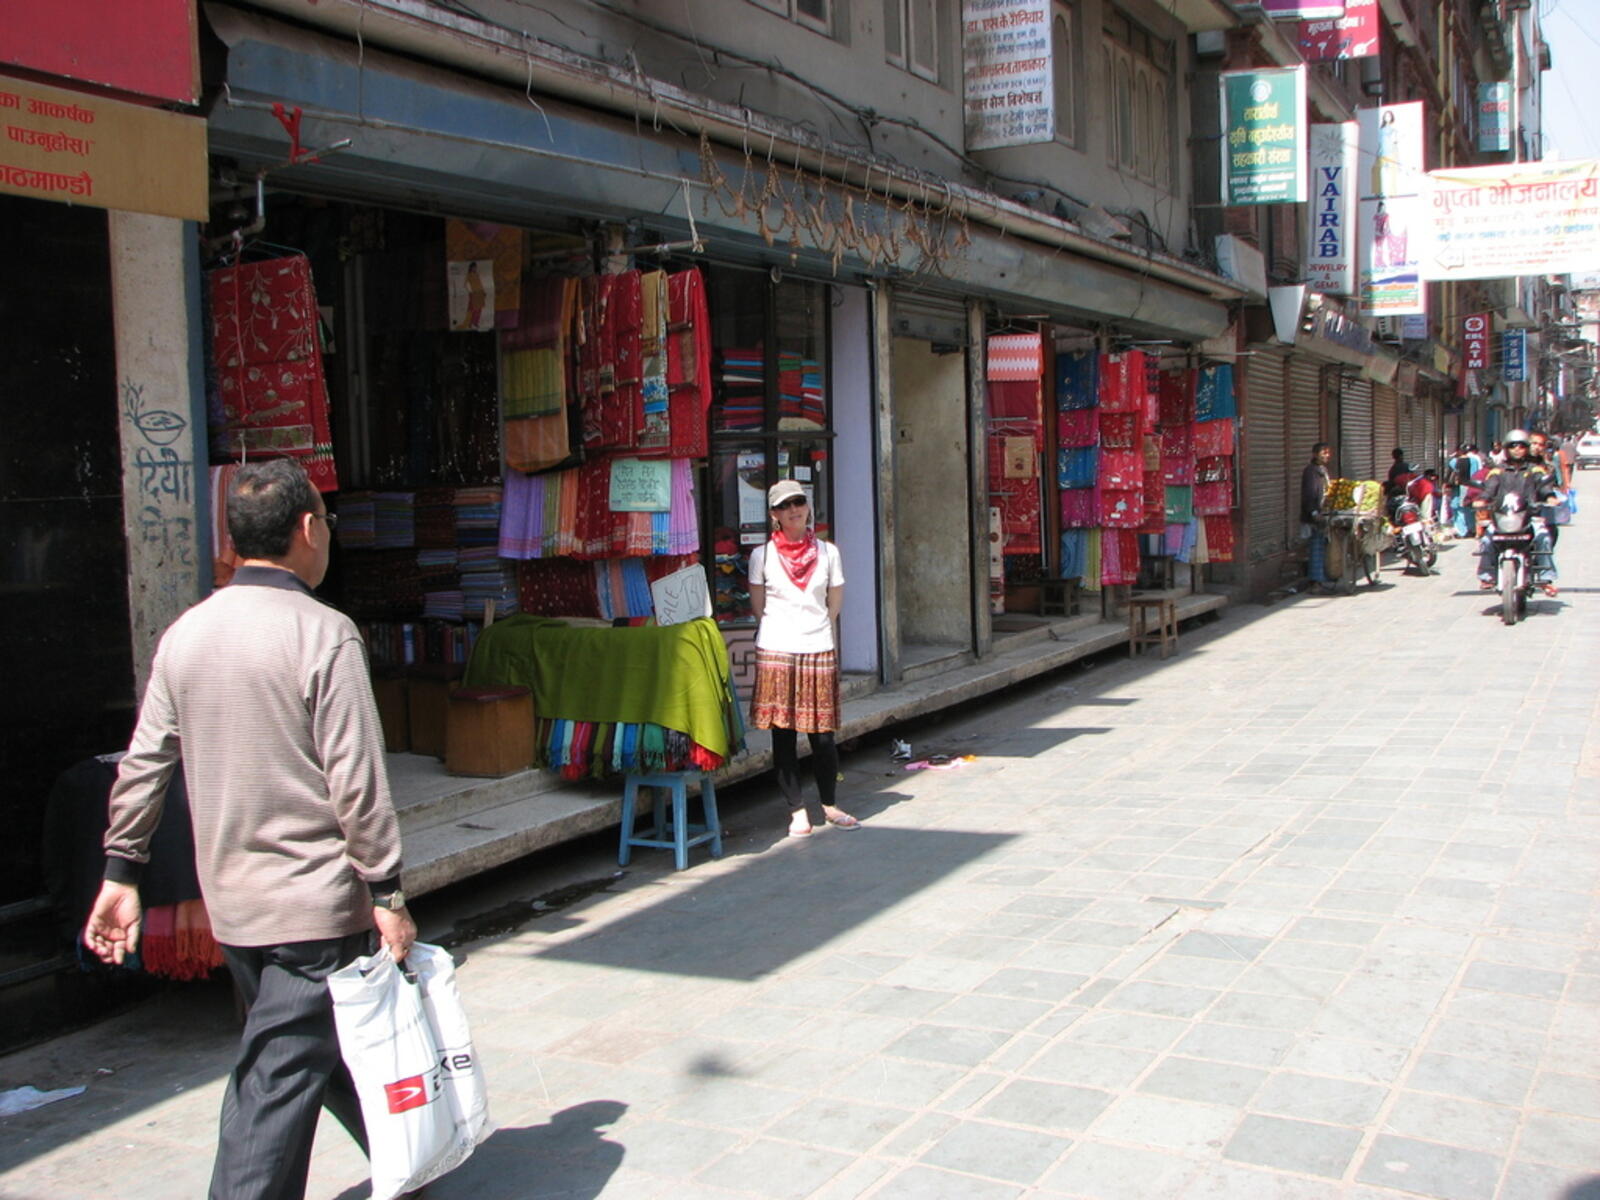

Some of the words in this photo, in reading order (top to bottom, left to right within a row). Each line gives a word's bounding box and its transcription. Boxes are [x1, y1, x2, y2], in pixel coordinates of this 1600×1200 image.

[27, 97, 95, 124] आकर्षक
[1433, 187, 1481, 214] गुप्ता
[1488, 178, 1599, 206] भोजनालय
[1319, 166, 1342, 257] VAIRAB
[1308, 264, 1347, 273] JEWELRY
[1314, 281, 1339, 290] GEMS
[1468, 342, 1483, 368] ATM
